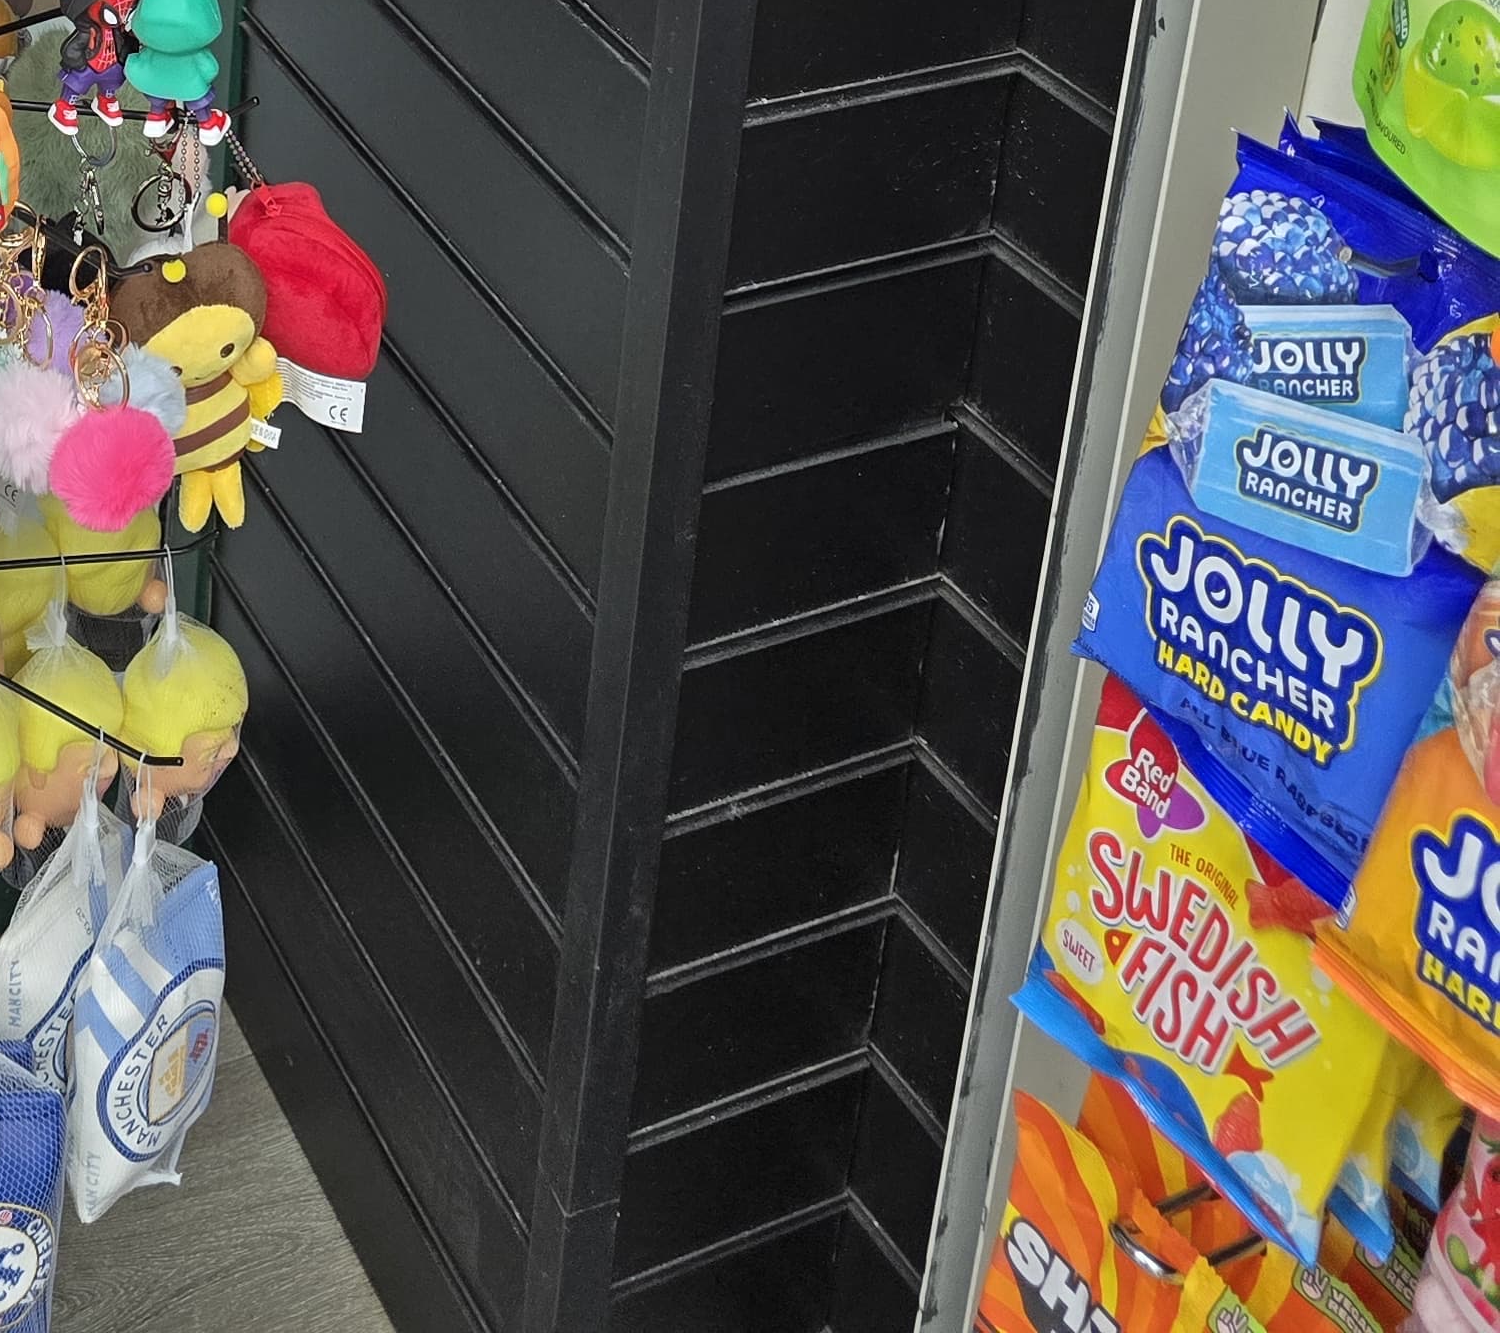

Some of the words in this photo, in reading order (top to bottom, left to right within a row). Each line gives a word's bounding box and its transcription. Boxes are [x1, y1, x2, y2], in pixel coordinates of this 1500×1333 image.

[1252, 340, 1360, 375] JOLLY
[1256, 378, 1355, 398] RANCHER
[1242, 432, 1371, 500] JOLLY
[1245, 470, 1353, 525] RANCHER
[1150, 536, 1363, 689] JOLLY
[1159, 595, 1335, 729] RANCHER
[1156, 643, 1226, 703] HARD
[1229, 690, 1334, 764] CANDY
[1180, 696, 1216, 730] ALL
[1220, 728, 1271, 773] BLUE
[1120, 763, 1171, 820] Band
[1133, 746, 1176, 794] Red
[1169, 842, 1193, 869] THE
[1195, 856, 1241, 912] ORIGINAL
[9, 958, 23, 994] CITY
[1061, 928, 1096, 974] SWEET
[1086, 829, 1320, 1066] SWEDISH
[8, 994, 22, 1027] MAN
[1119, 934, 1234, 1072] FISH
[115, 1012, 169, 1149] MANCHESTER
[86, 1150, 101, 1187] CITY
[23, 1216, 55, 1306] CHELSEA
